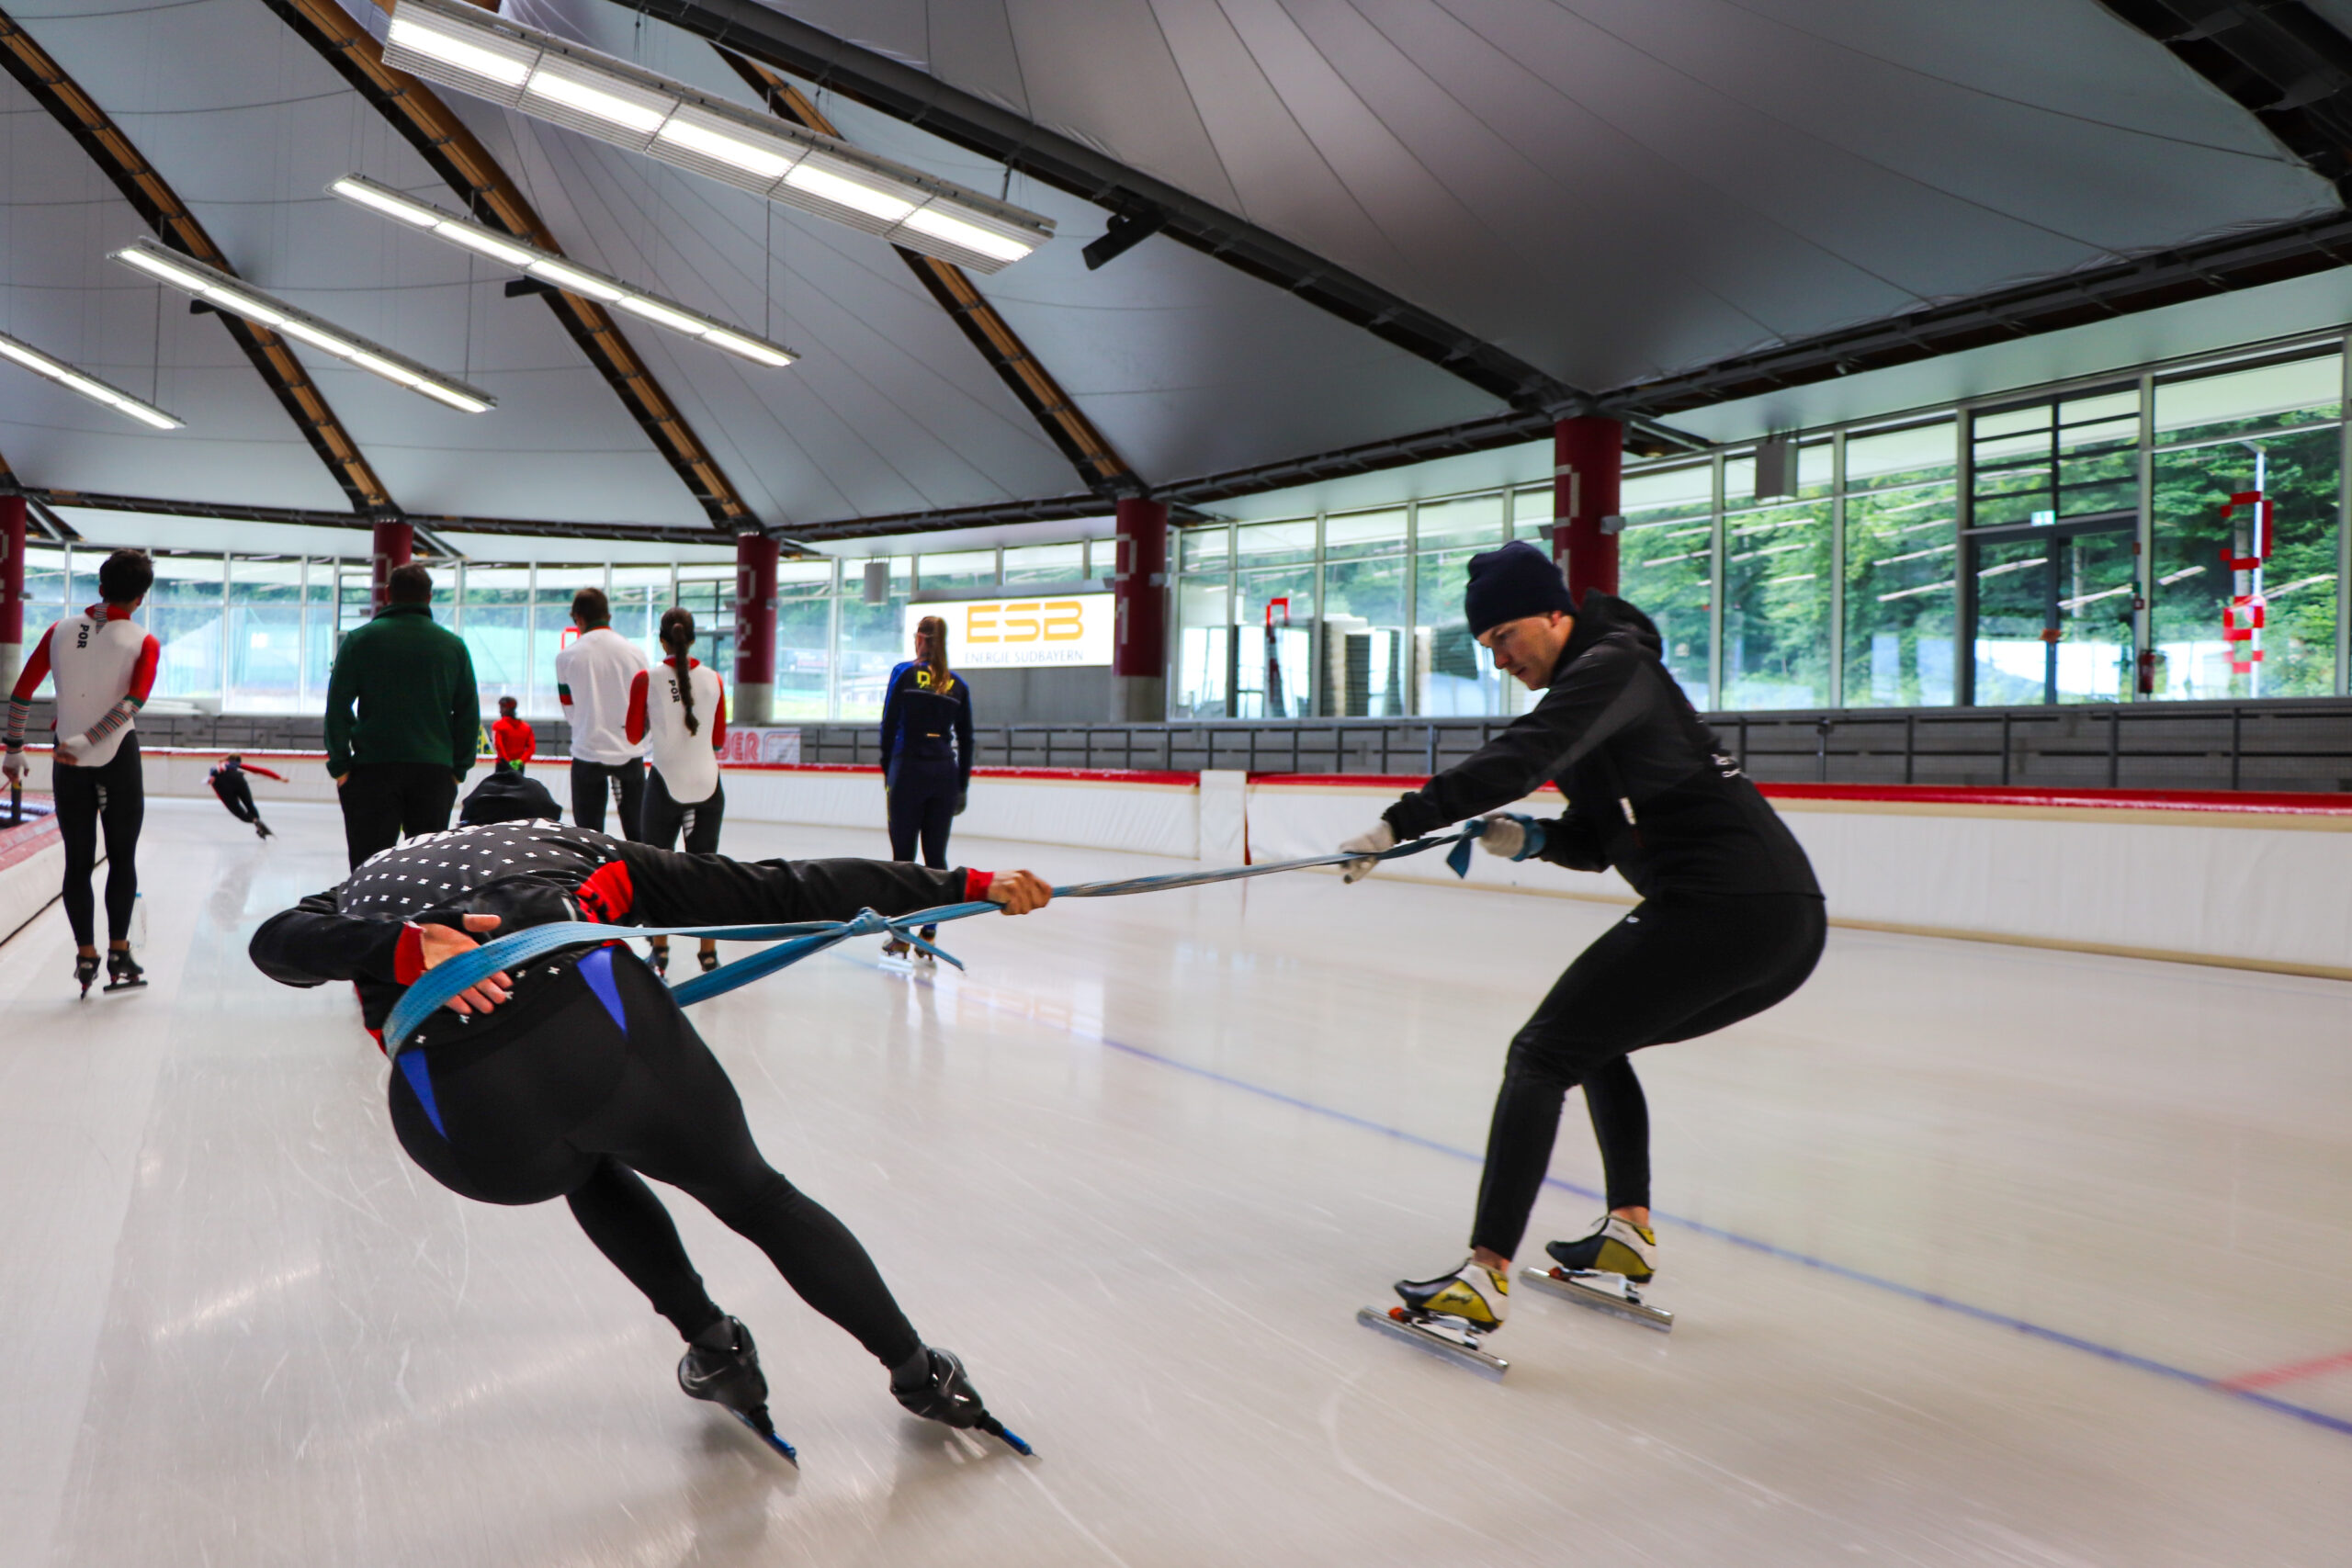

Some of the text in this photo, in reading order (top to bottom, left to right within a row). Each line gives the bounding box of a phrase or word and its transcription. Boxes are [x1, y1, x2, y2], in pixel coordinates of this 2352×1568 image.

[967, 601, 1084, 643] ESB
[76, 624, 90, 649] POR
[965, 651, 1010, 664] ENERGIE
[668, 679, 681, 704] POR
